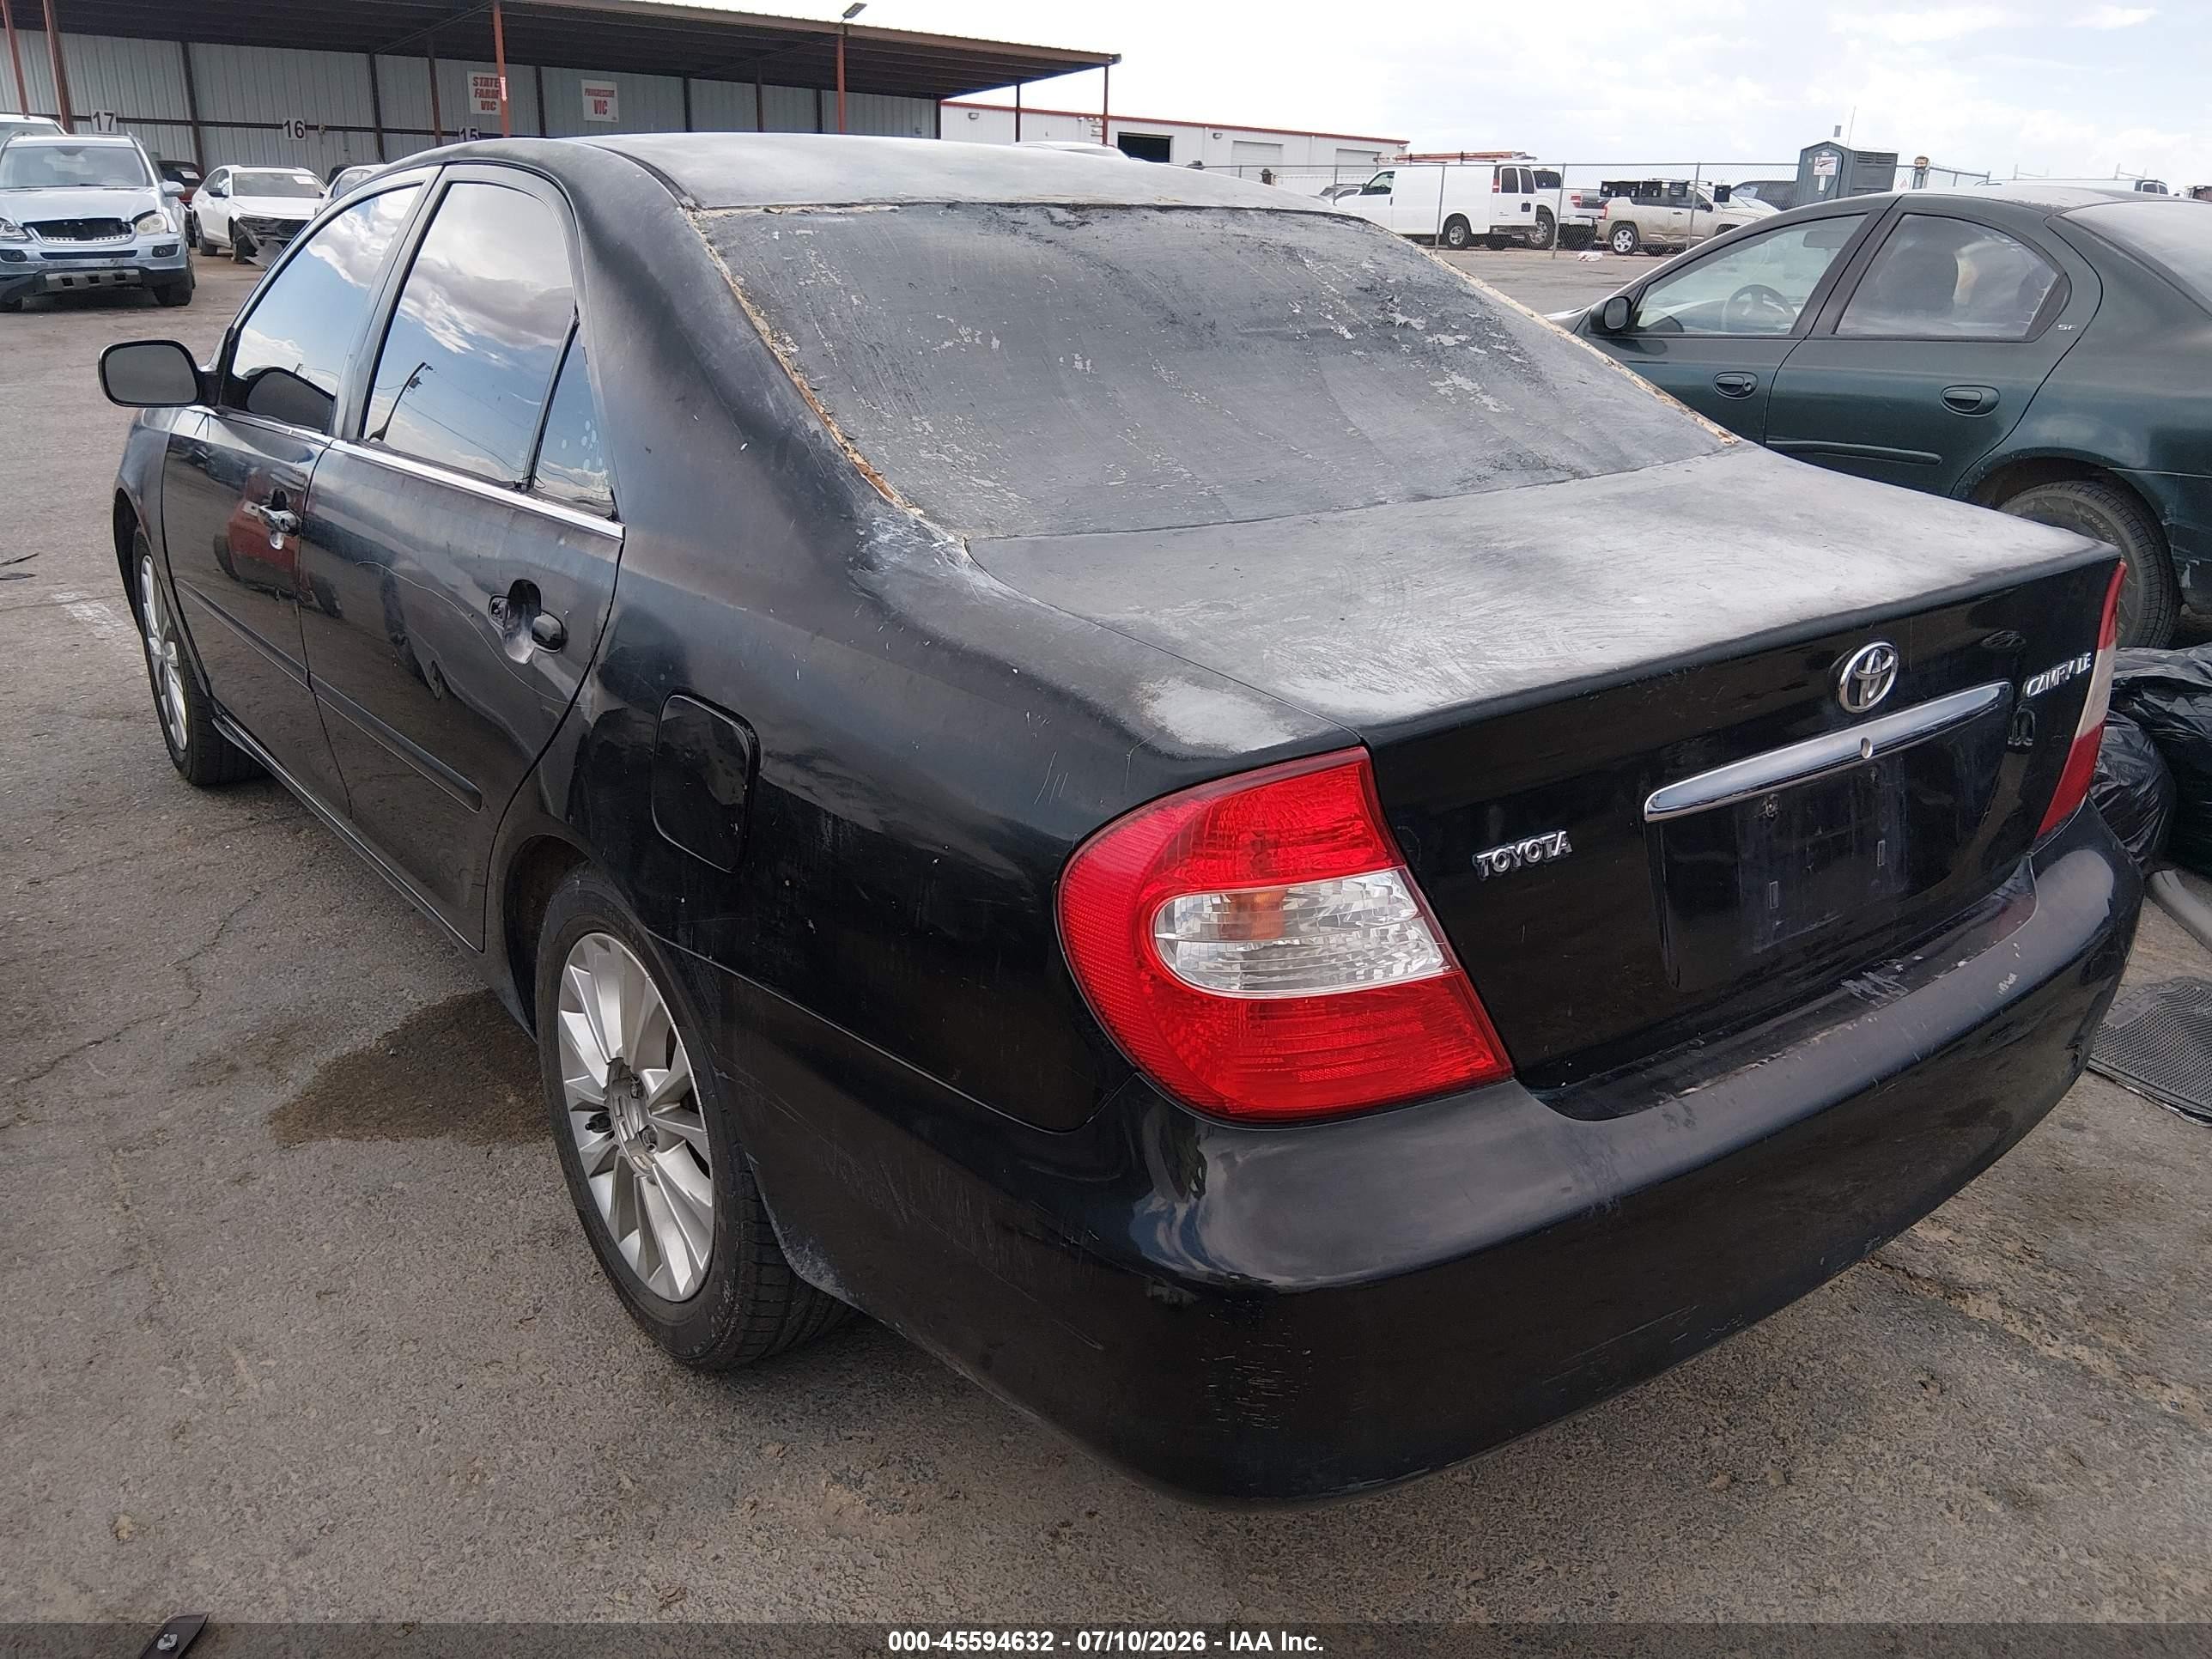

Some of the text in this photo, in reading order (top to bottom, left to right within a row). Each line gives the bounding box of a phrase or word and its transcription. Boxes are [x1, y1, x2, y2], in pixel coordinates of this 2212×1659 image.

[473, 76, 500, 88] STATE
[481, 100, 496, 111] VIC
[594, 100, 608, 115] VIC
[93, 111, 114, 131] 17
[283, 119, 305, 139] 16
[460, 128, 479, 142] 15
[2023, 659, 2075, 697] CAMRY
[1474, 830, 1573, 878] TOYOTA
